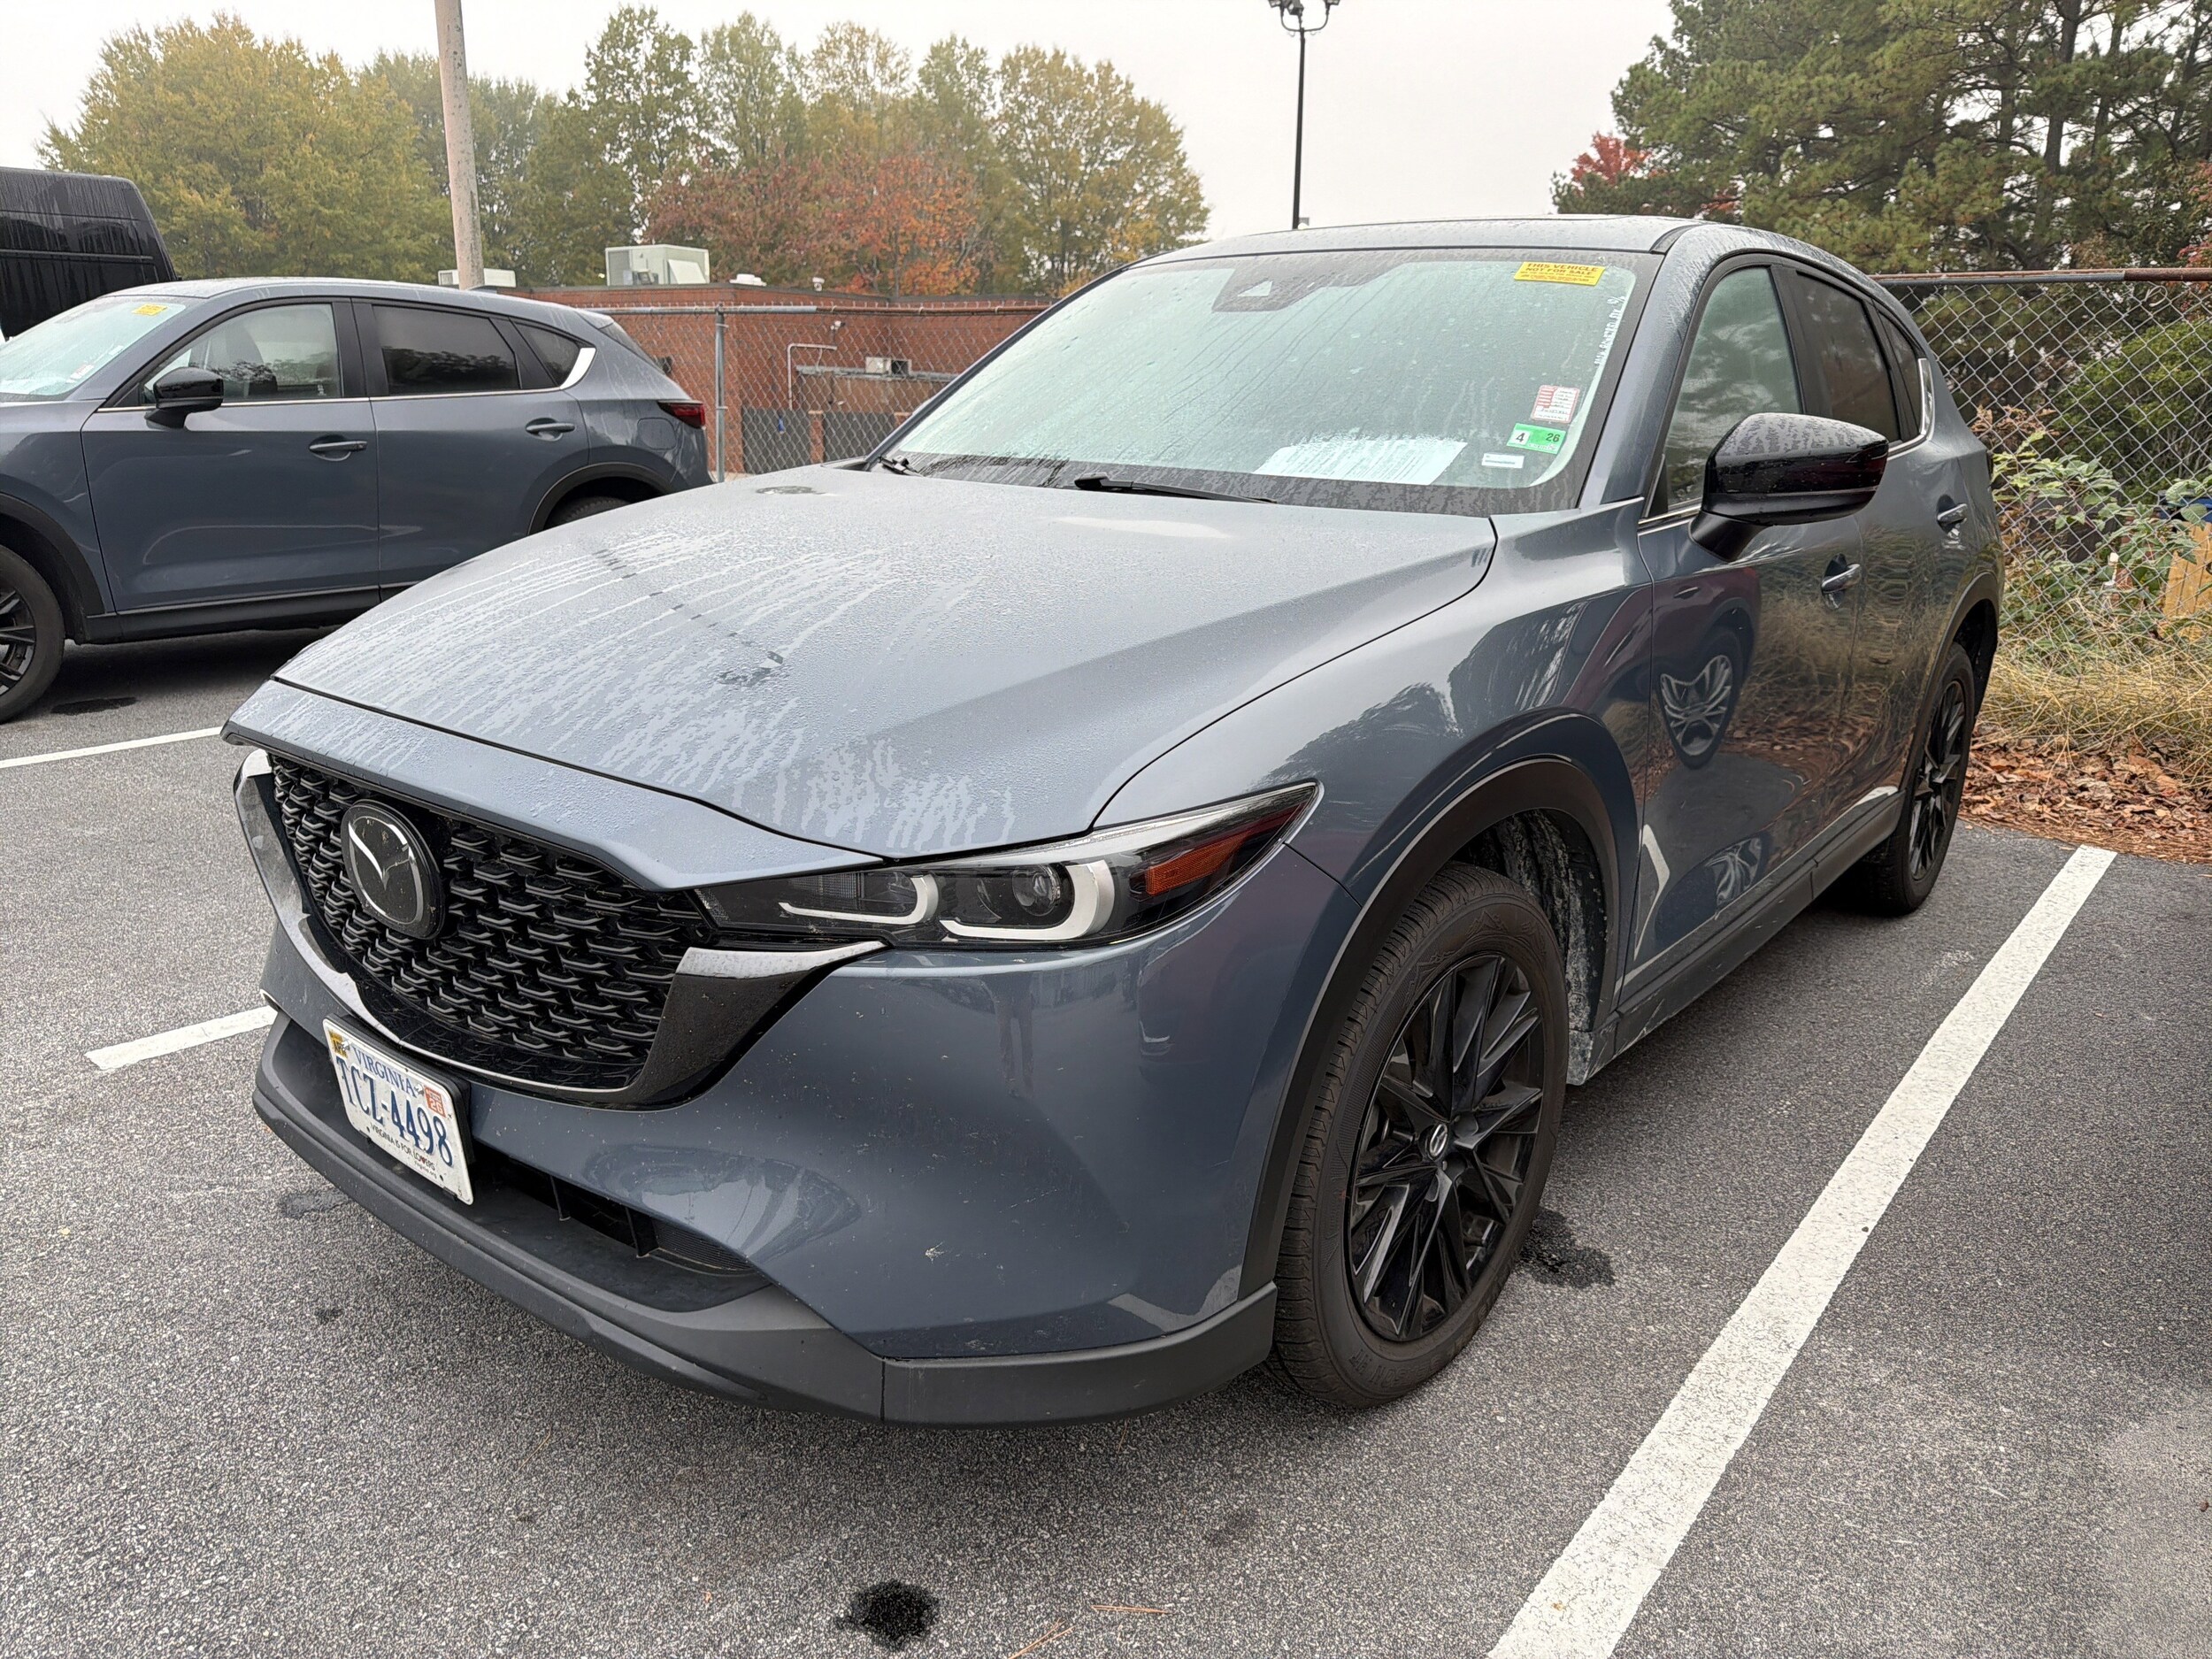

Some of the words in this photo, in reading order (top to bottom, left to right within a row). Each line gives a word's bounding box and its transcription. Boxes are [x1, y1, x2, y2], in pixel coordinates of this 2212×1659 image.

[1553, 264, 1599, 273] VEHICLE
[1516, 433, 1525, 442] 4
[1545, 432, 1561, 442] 26
[353, 1047, 417, 1098] VIRGINIA
[335, 1056, 454, 1168] TCZ-4498
[429, 1098, 444, 1115] 26
[371, 1123, 395, 1144] VIRGINIA
[400, 1142, 413, 1157] FOR
